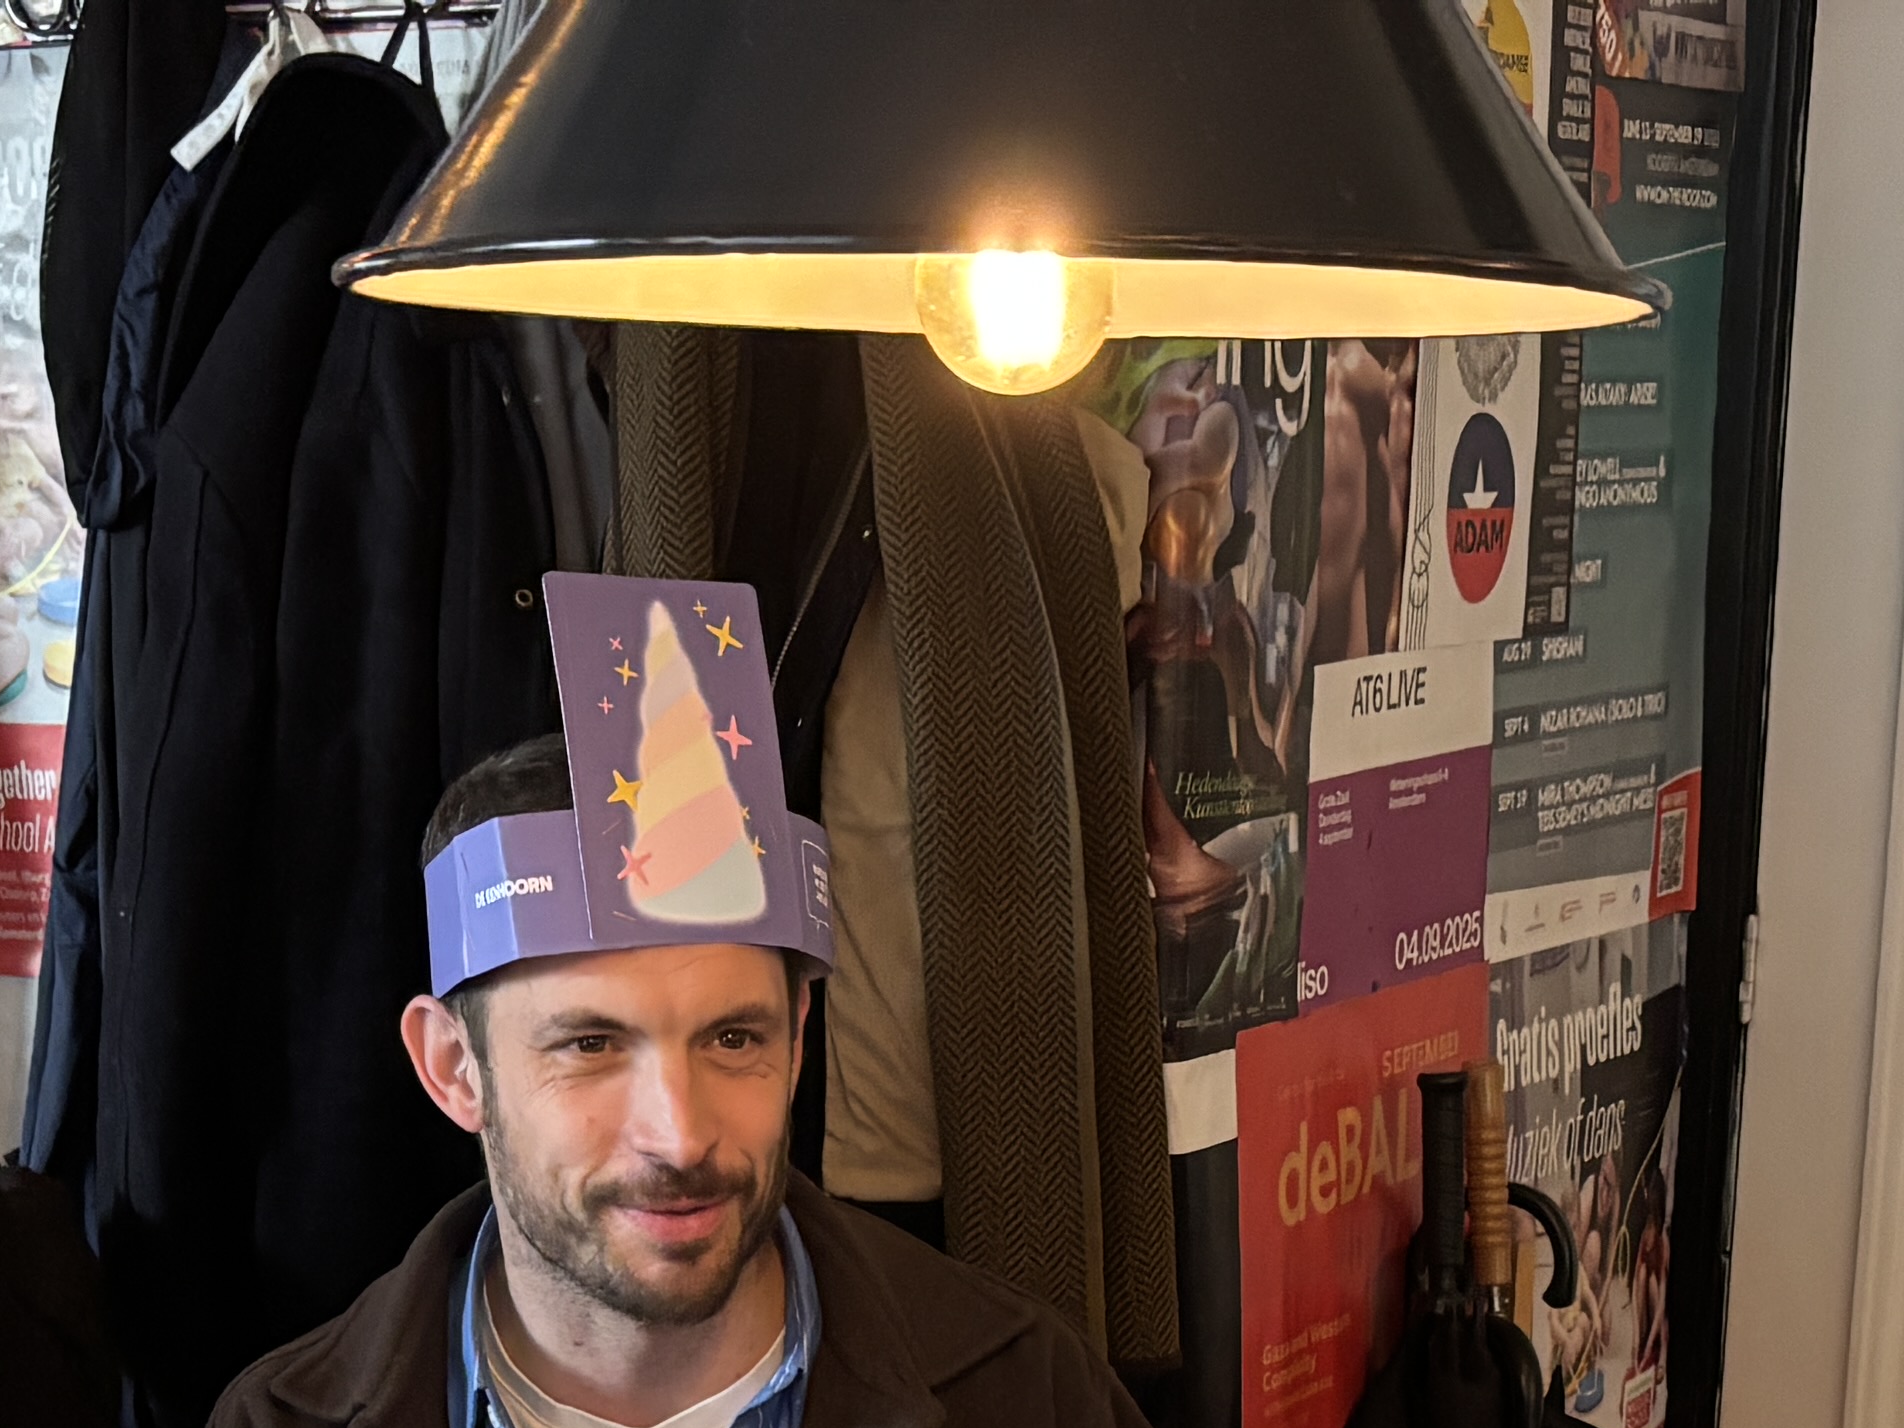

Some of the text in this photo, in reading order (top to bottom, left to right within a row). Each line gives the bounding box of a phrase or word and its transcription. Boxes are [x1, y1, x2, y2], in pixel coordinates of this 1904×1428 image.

[1453, 518, 1506, 556] ADAM
[1352, 665, 1428, 719] AT6 LIVE
[1395, 909, 1482, 972] 04.09.2025
[1497, 982, 1643, 1096] Gratis proefles
[1564, 1096, 1585, 1174] of
[1584, 1093, 1626, 1163] dans
